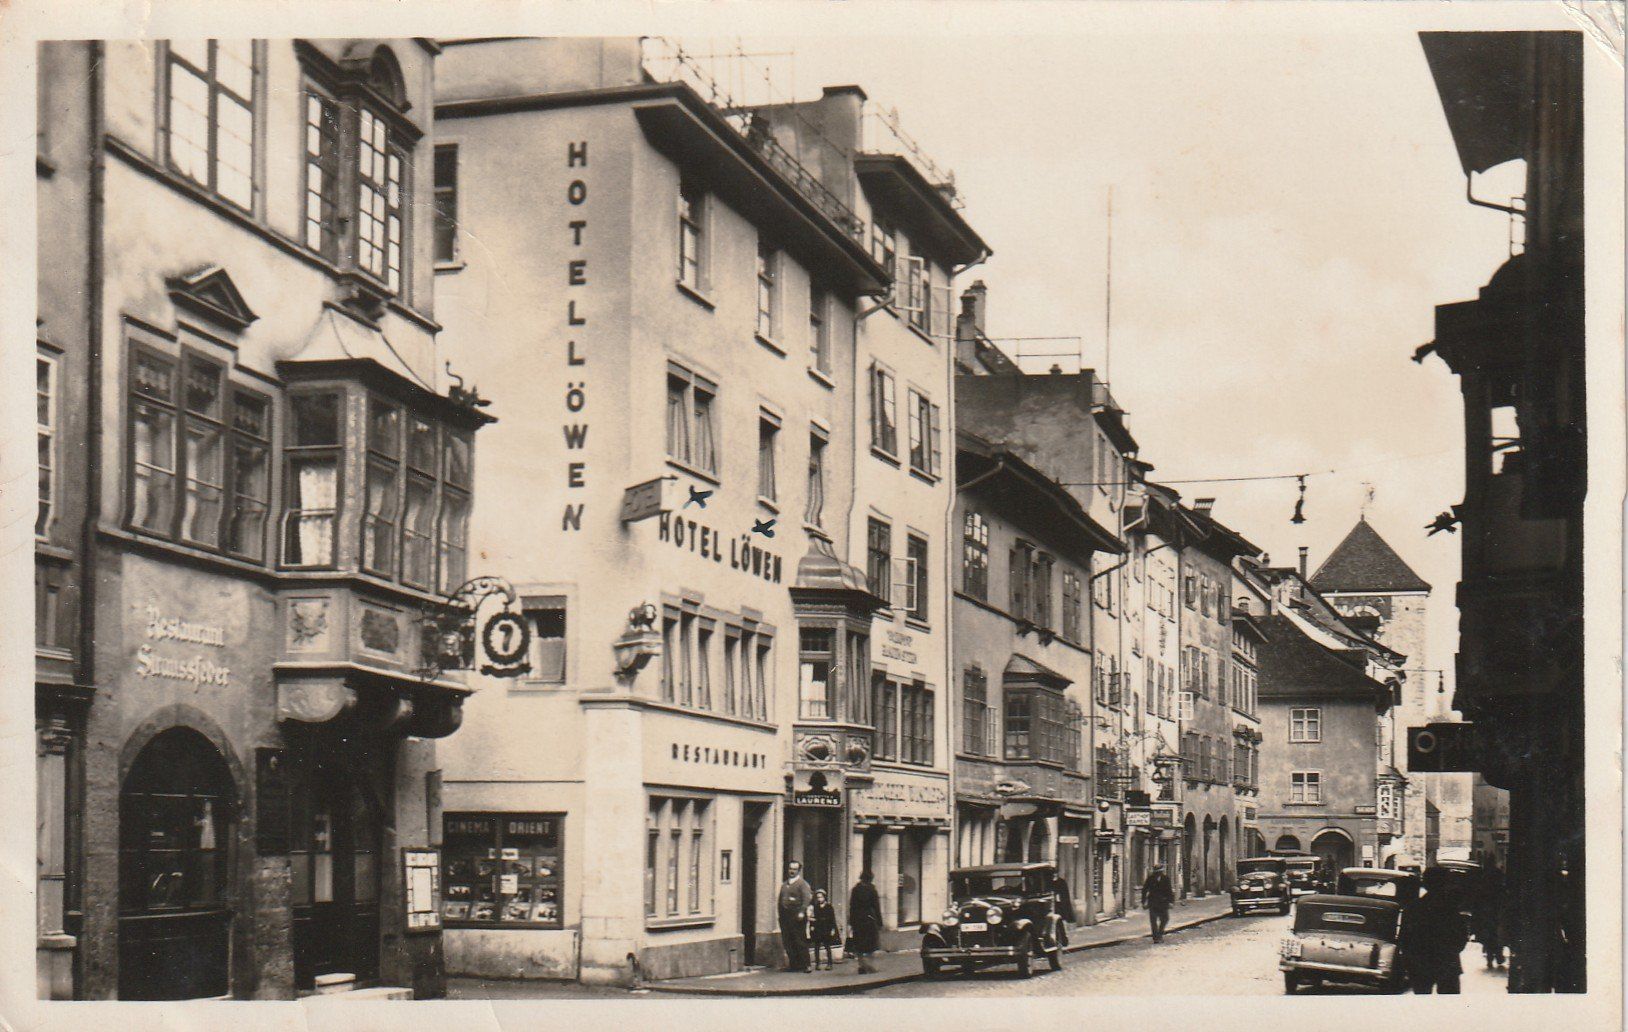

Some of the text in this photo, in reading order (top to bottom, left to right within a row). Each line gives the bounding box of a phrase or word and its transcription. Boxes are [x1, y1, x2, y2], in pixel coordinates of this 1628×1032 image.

[562, 141, 588, 531] HOTEL LÖWEN
[659, 512, 783, 584] HOTEL LÖWEN
[671, 742, 767, 769] RESTAURANT
[796, 796, 838, 806] LAURENS
[447, 821, 551, 834] CINEMA ORIENT
